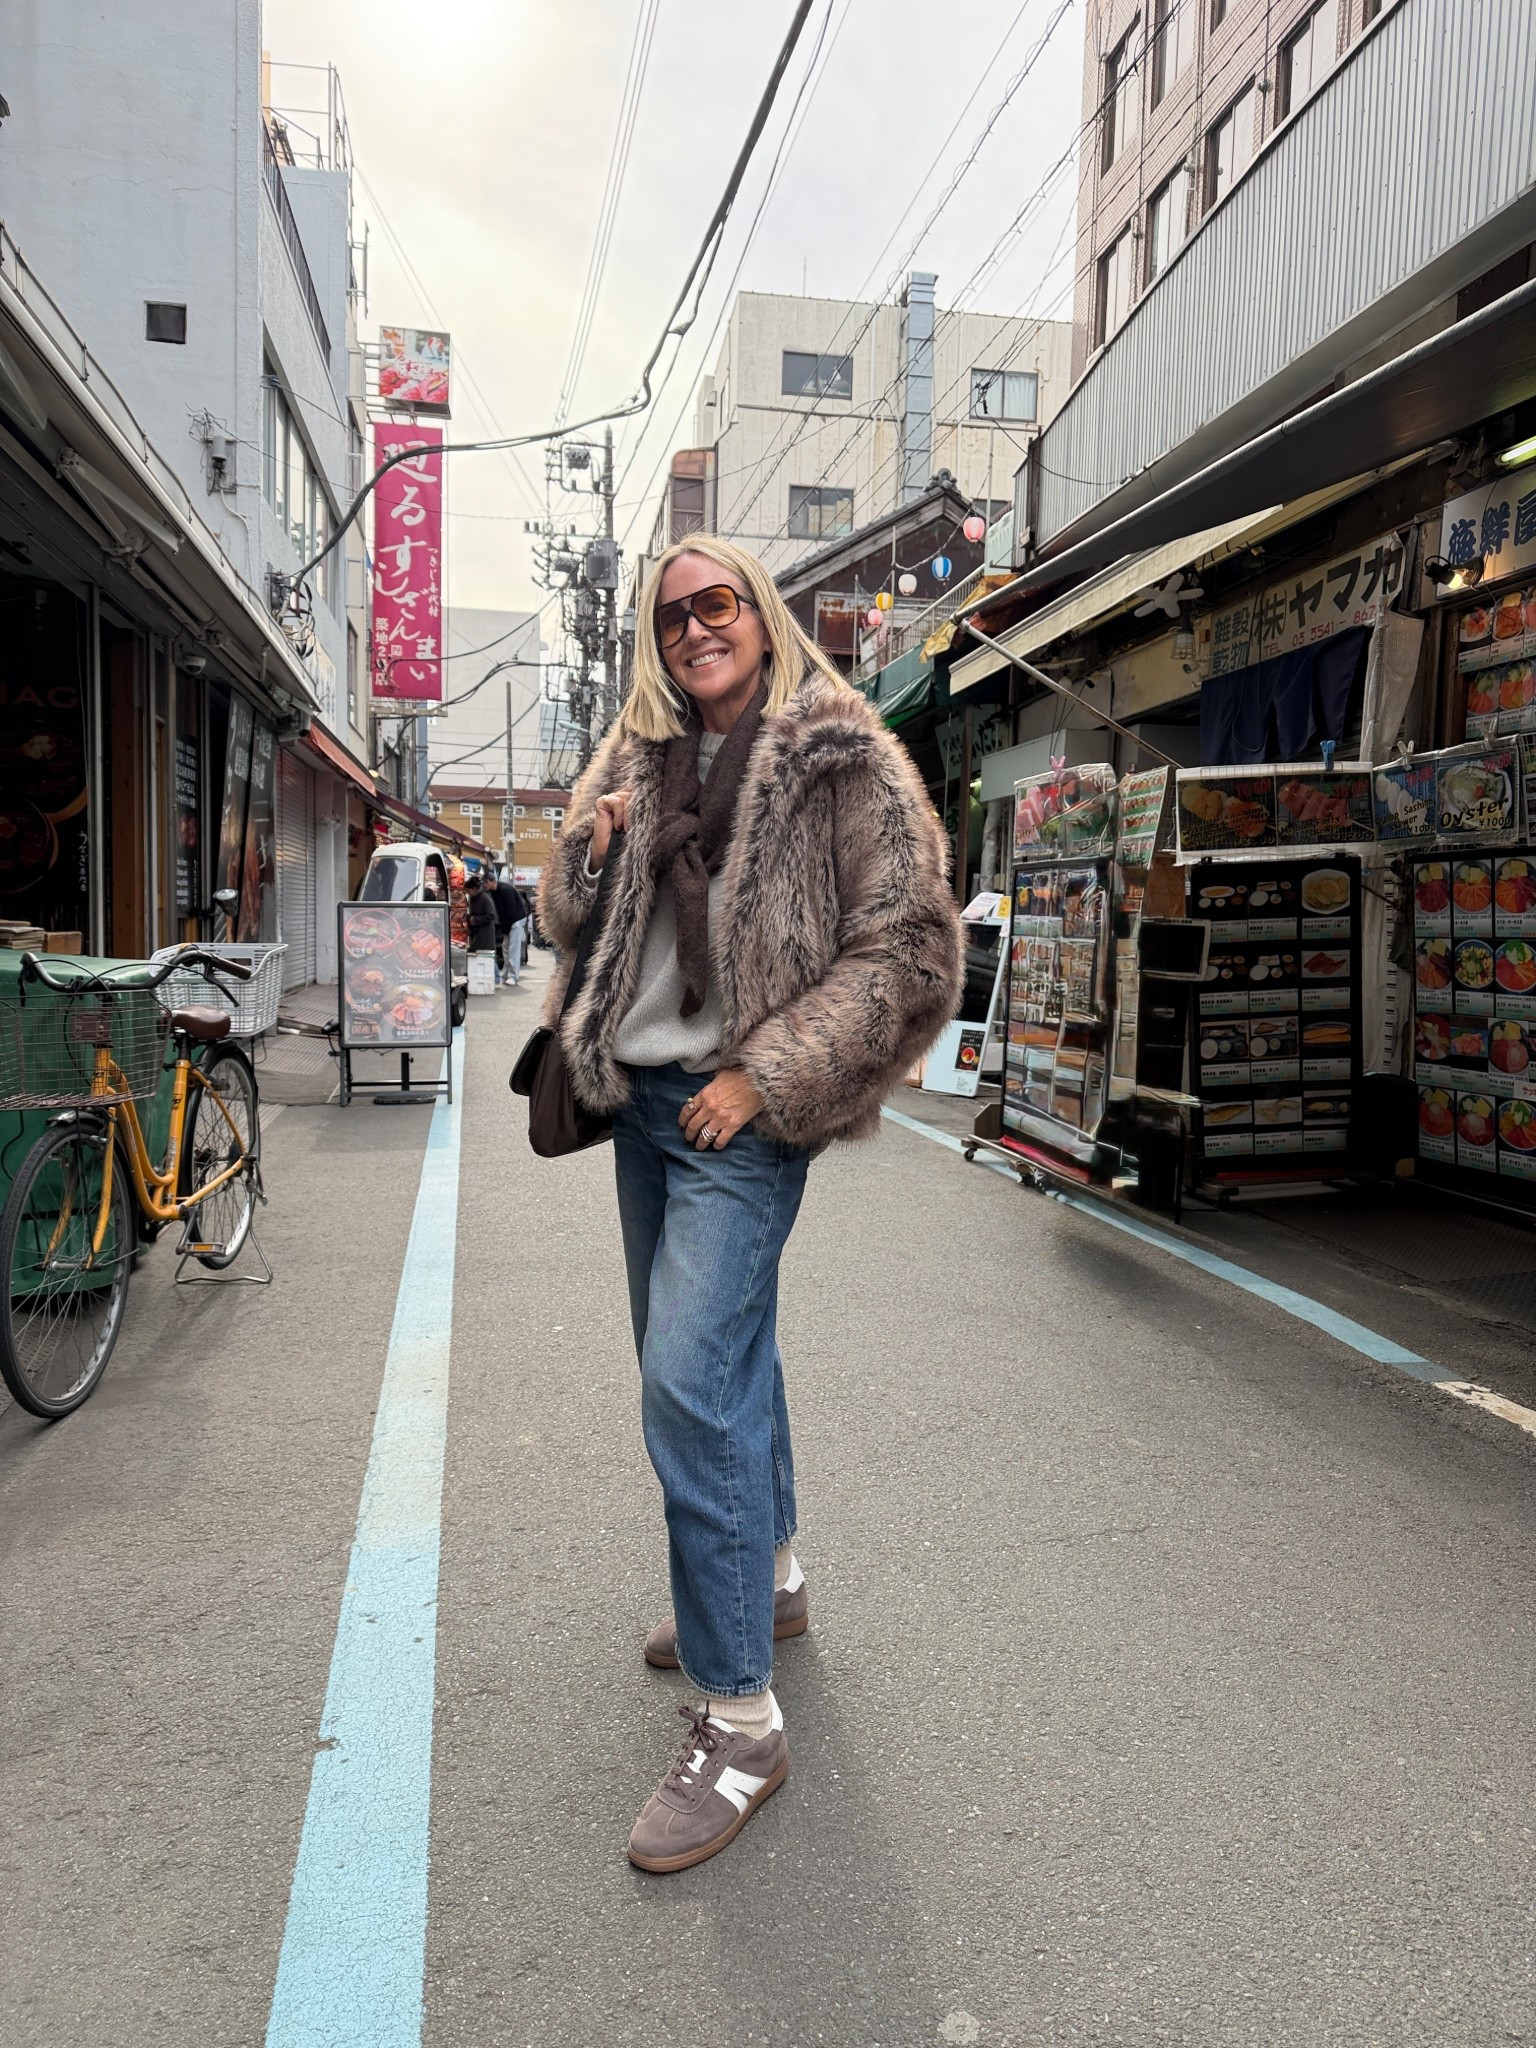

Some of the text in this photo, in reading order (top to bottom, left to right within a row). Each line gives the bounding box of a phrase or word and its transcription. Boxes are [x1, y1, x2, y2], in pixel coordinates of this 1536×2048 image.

[1263, 643, 1282, 656] TEL
[1292, 631, 1305, 646] 03
[1440, 796, 1510, 829] Oyster
[1479, 816, 1512, 828] ¥1000
